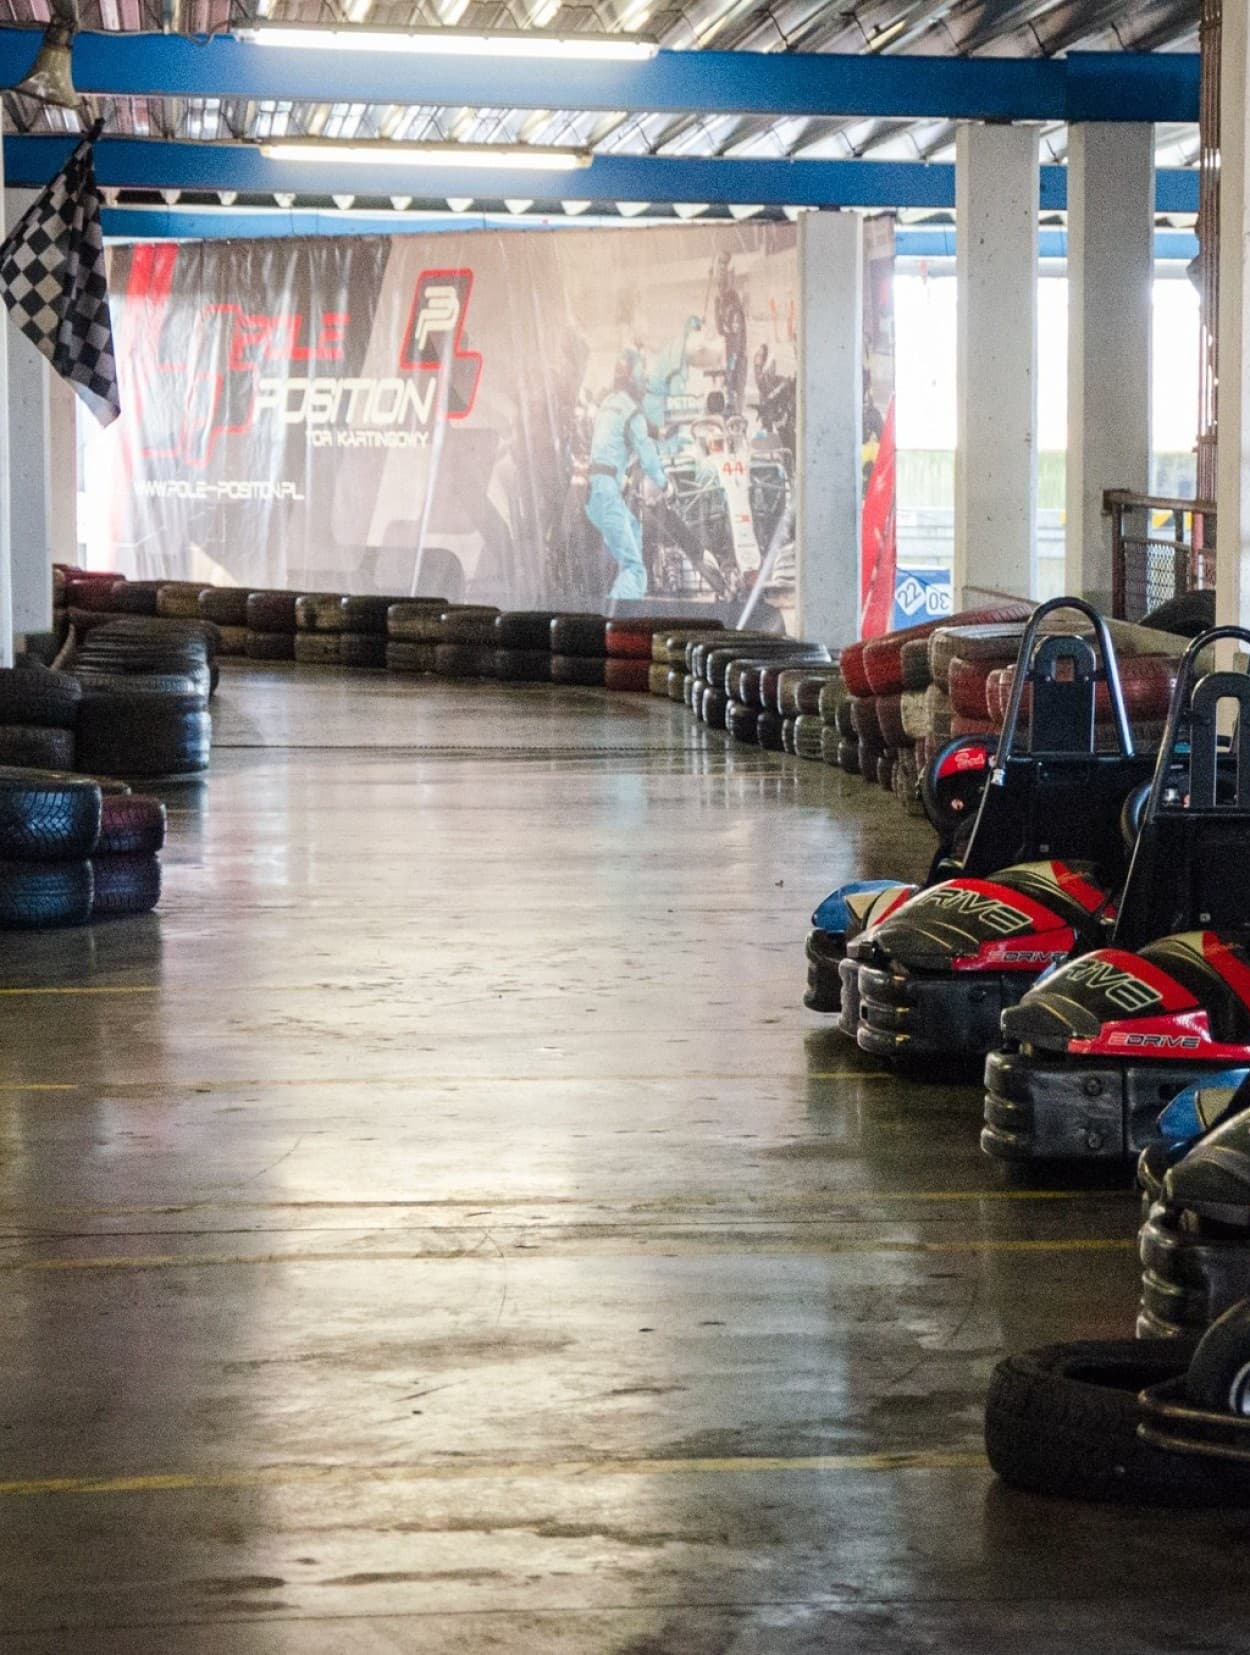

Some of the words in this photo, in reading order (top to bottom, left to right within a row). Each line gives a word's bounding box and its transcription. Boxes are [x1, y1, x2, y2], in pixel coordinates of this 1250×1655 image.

[252, 377, 437, 425] POSITION
[306, 430, 333, 448] TOR
[897, 582, 923, 609] 22
